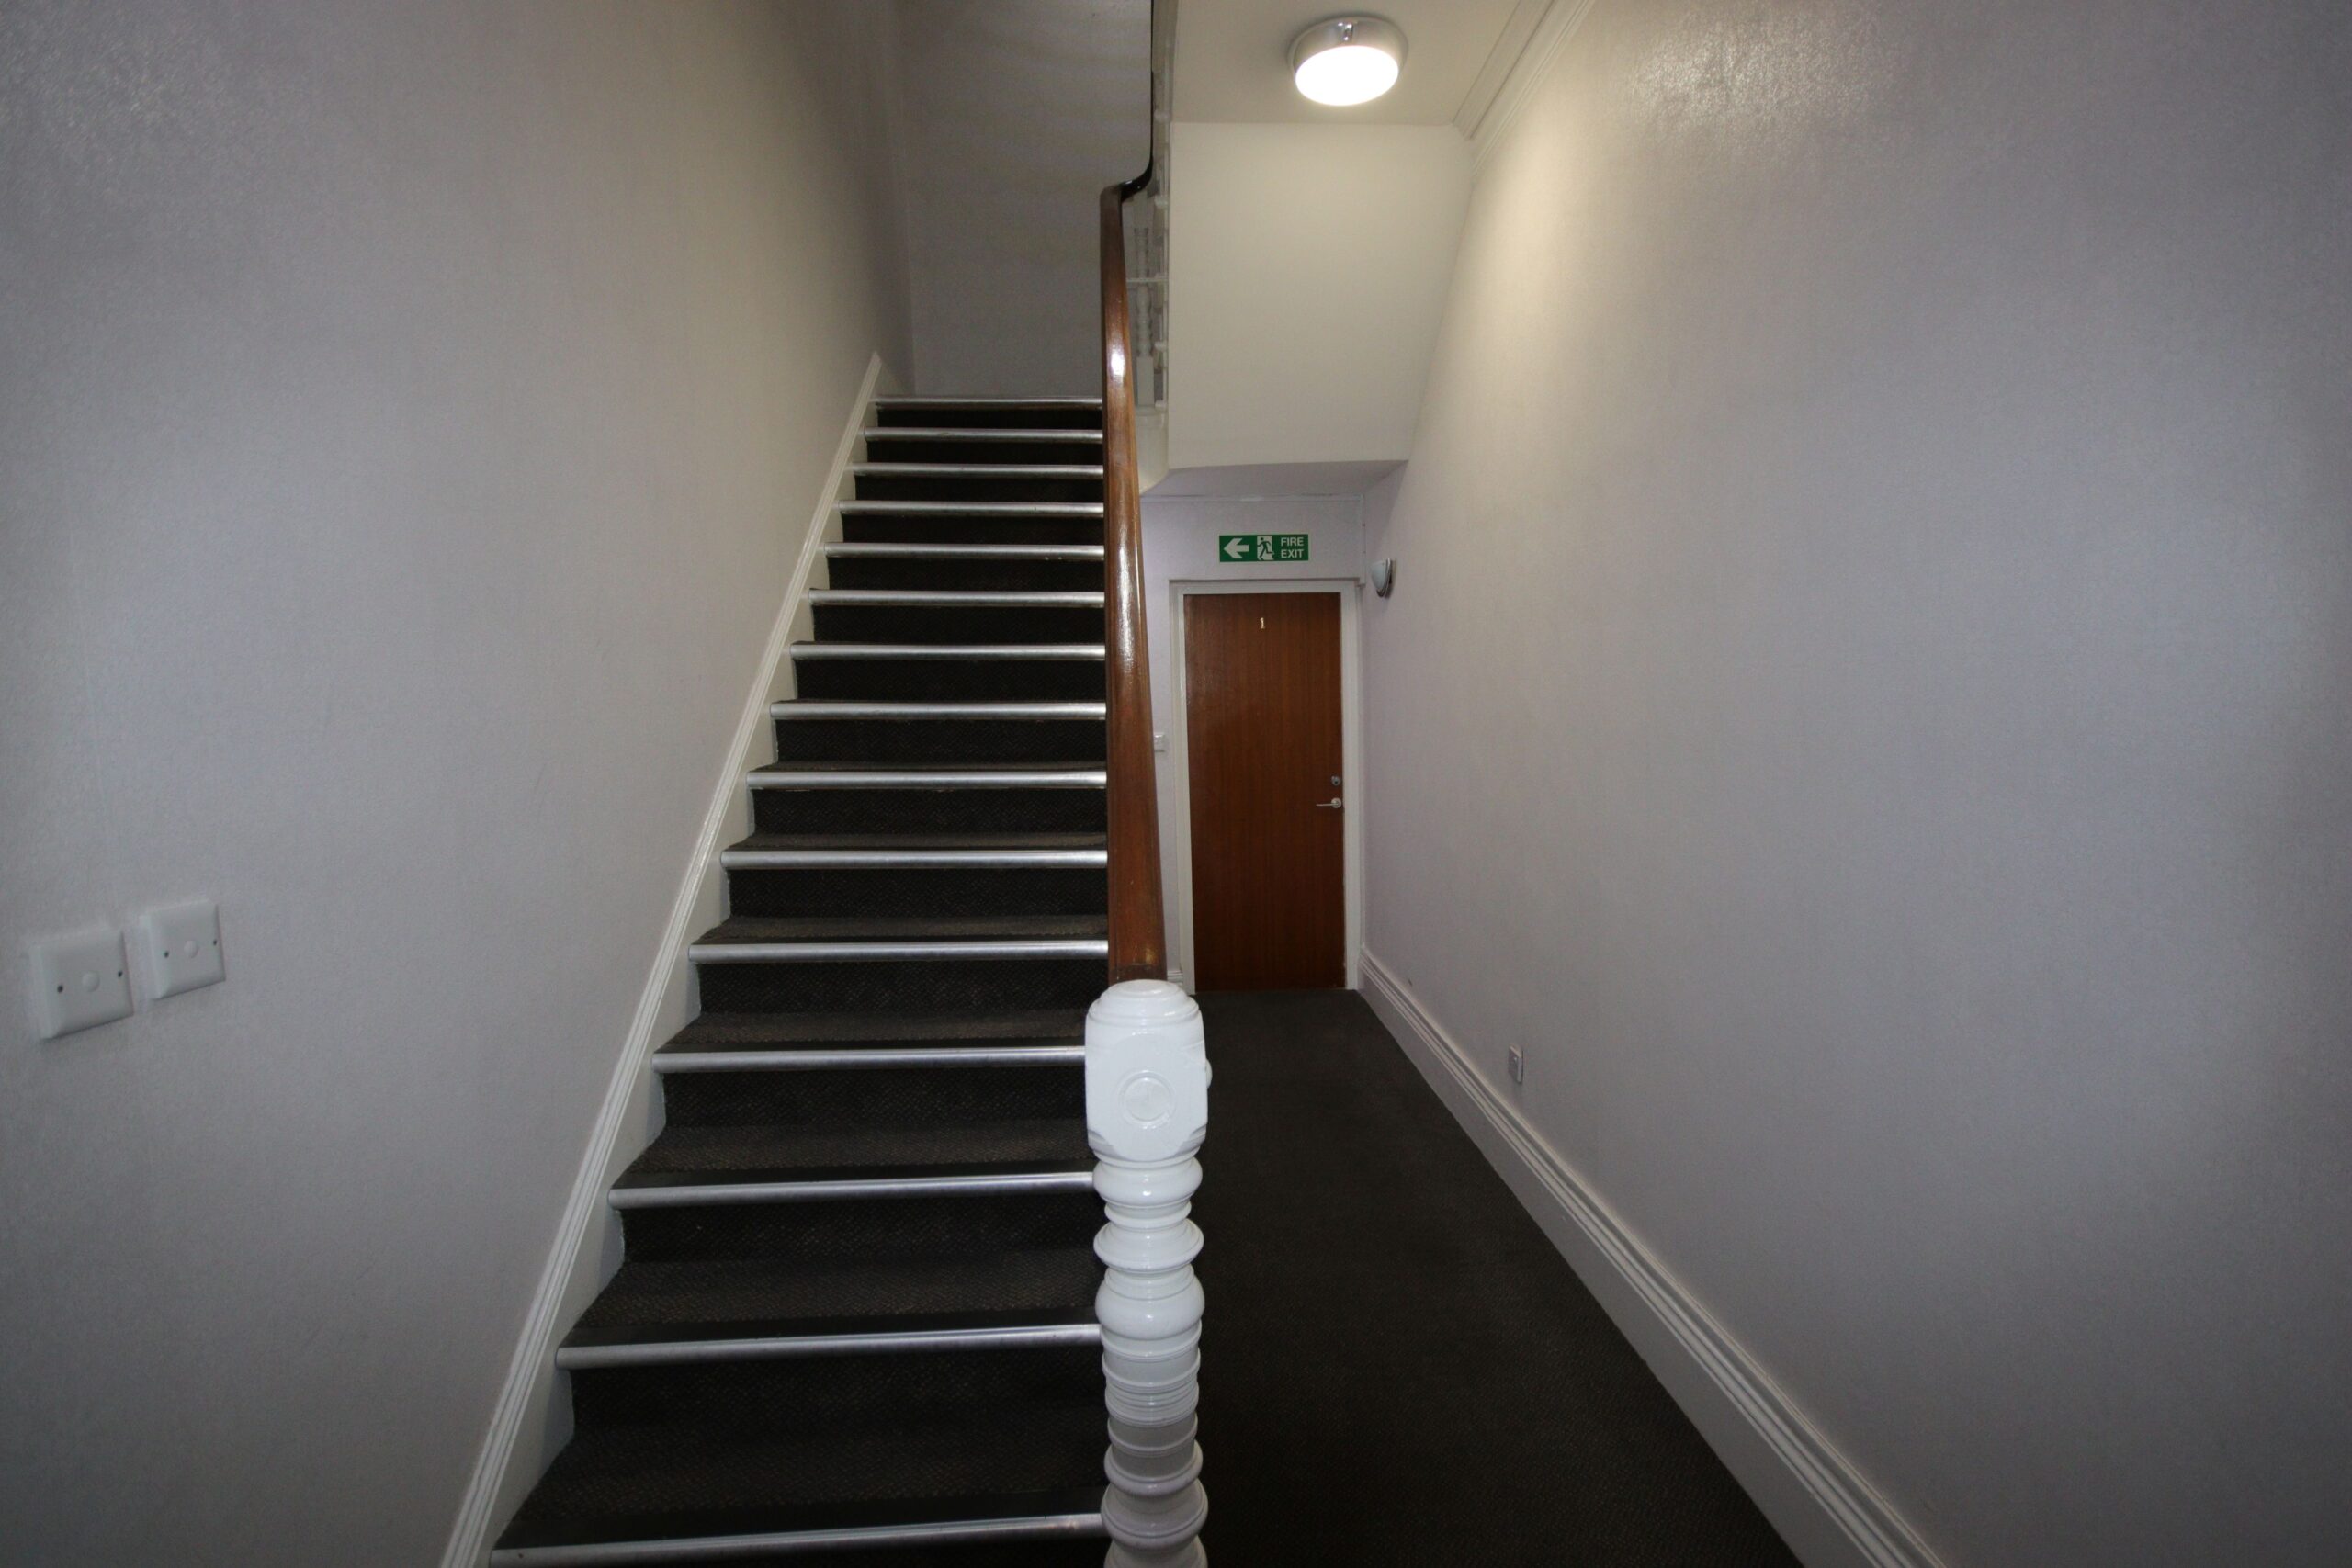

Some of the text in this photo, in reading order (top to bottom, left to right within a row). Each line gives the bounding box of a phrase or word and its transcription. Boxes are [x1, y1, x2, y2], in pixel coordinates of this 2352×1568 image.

[1281, 537, 1304, 547] FIRE
[1281, 549, 1304, 558] EXIT
[1260, 617, 1265, 629] 1
